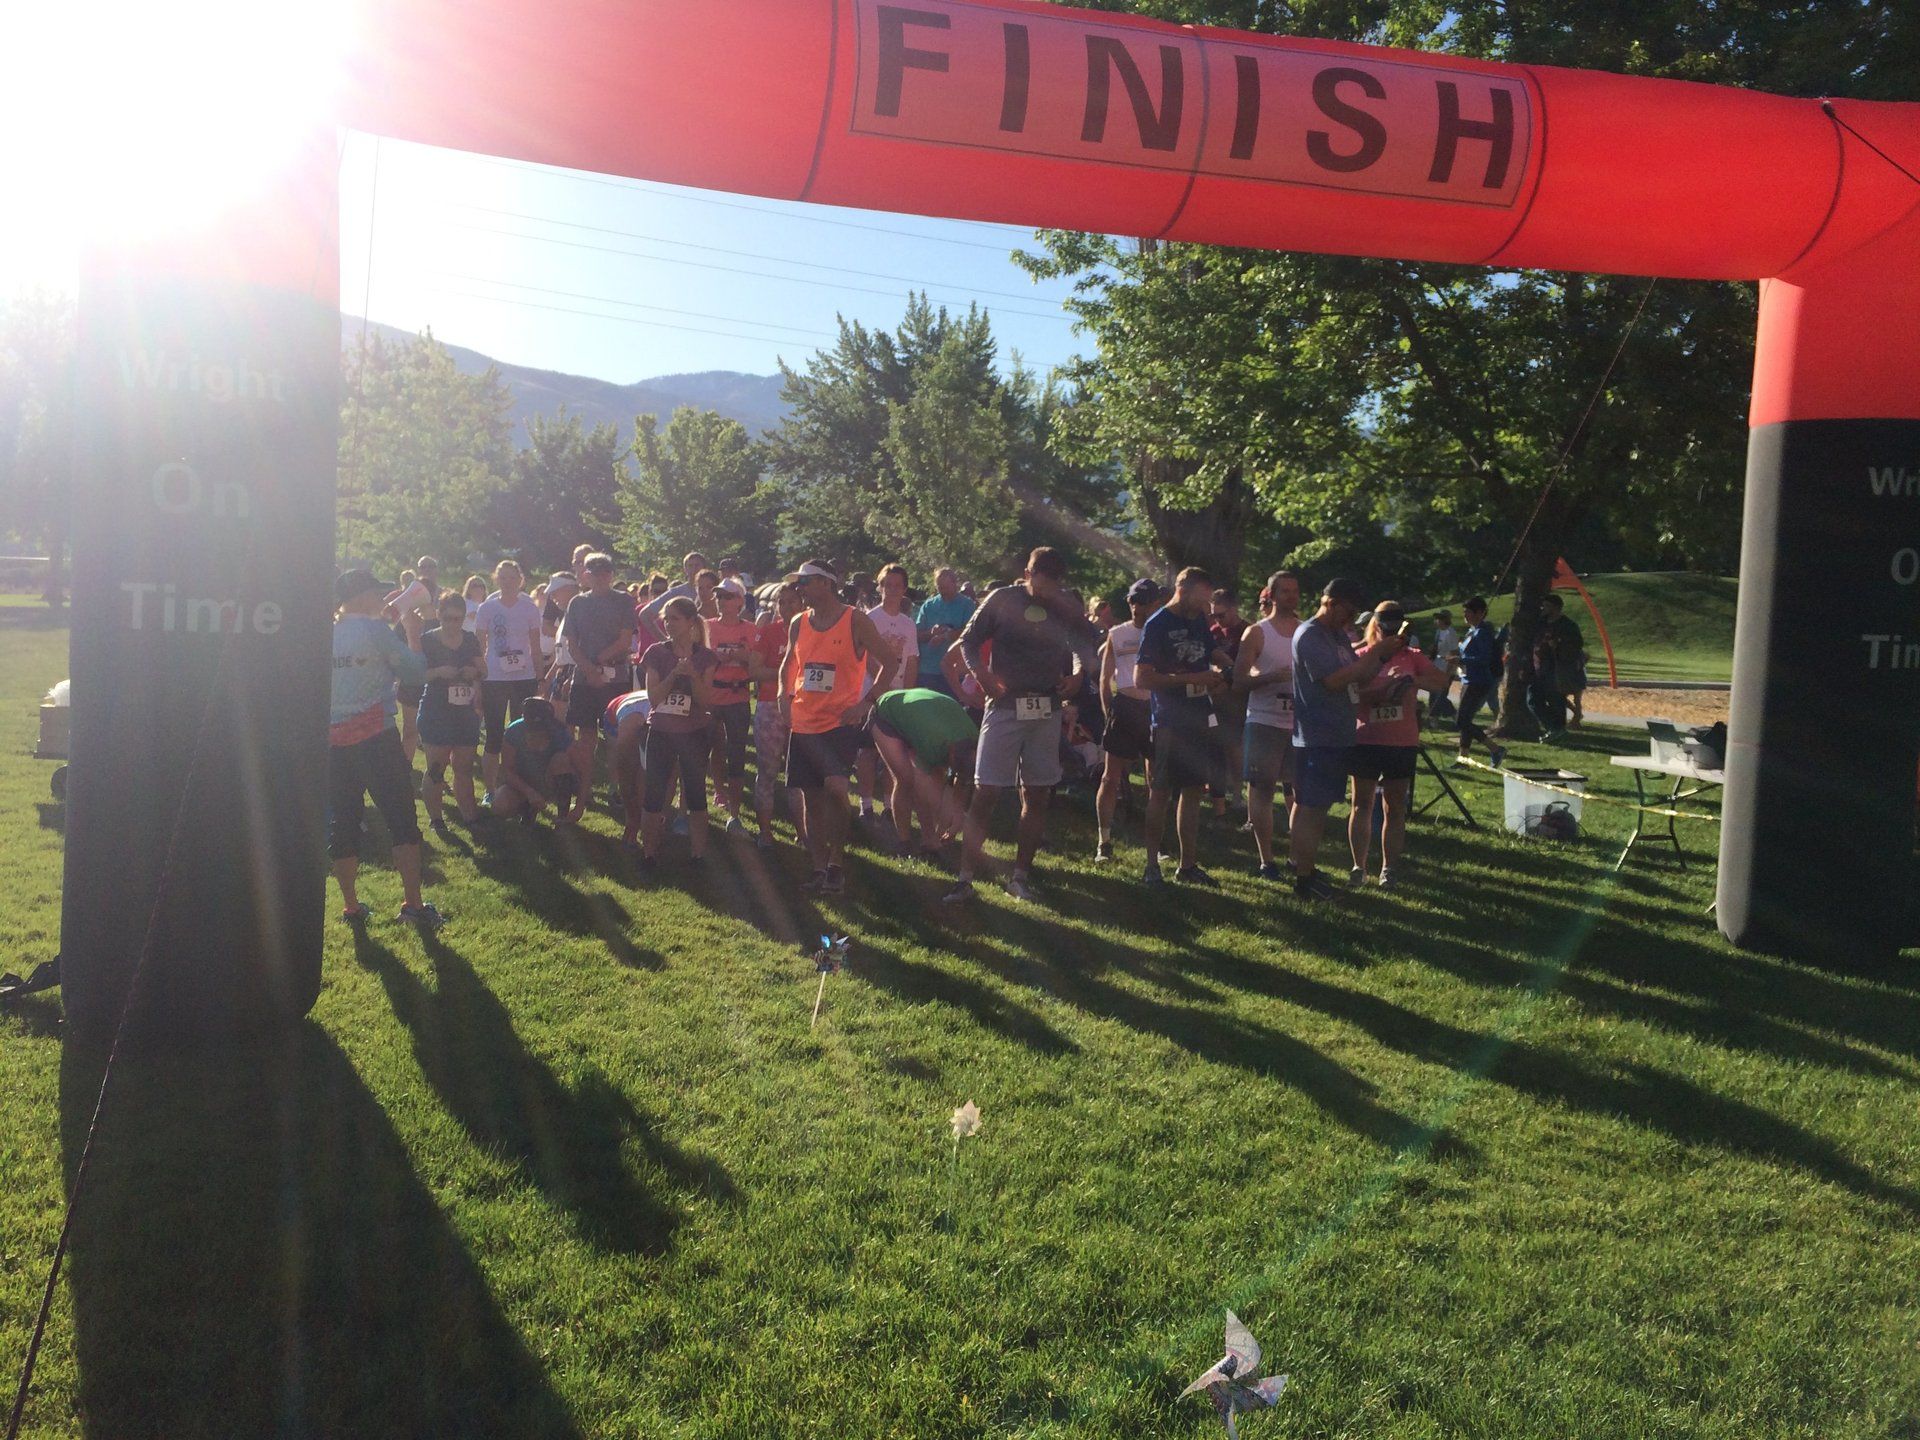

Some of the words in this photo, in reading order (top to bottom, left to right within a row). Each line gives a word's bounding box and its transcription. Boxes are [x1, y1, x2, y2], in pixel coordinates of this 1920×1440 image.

[874, 5, 1514, 188] FINISH
[119, 351, 287, 402] Wright
[153, 462, 249, 518] On
[121, 582, 282, 634] Time
[506, 655, 520, 665] 55
[809, 669, 824, 682] 29
[664, 694, 685, 707] 152
[1026, 697, 1041, 710] 51
